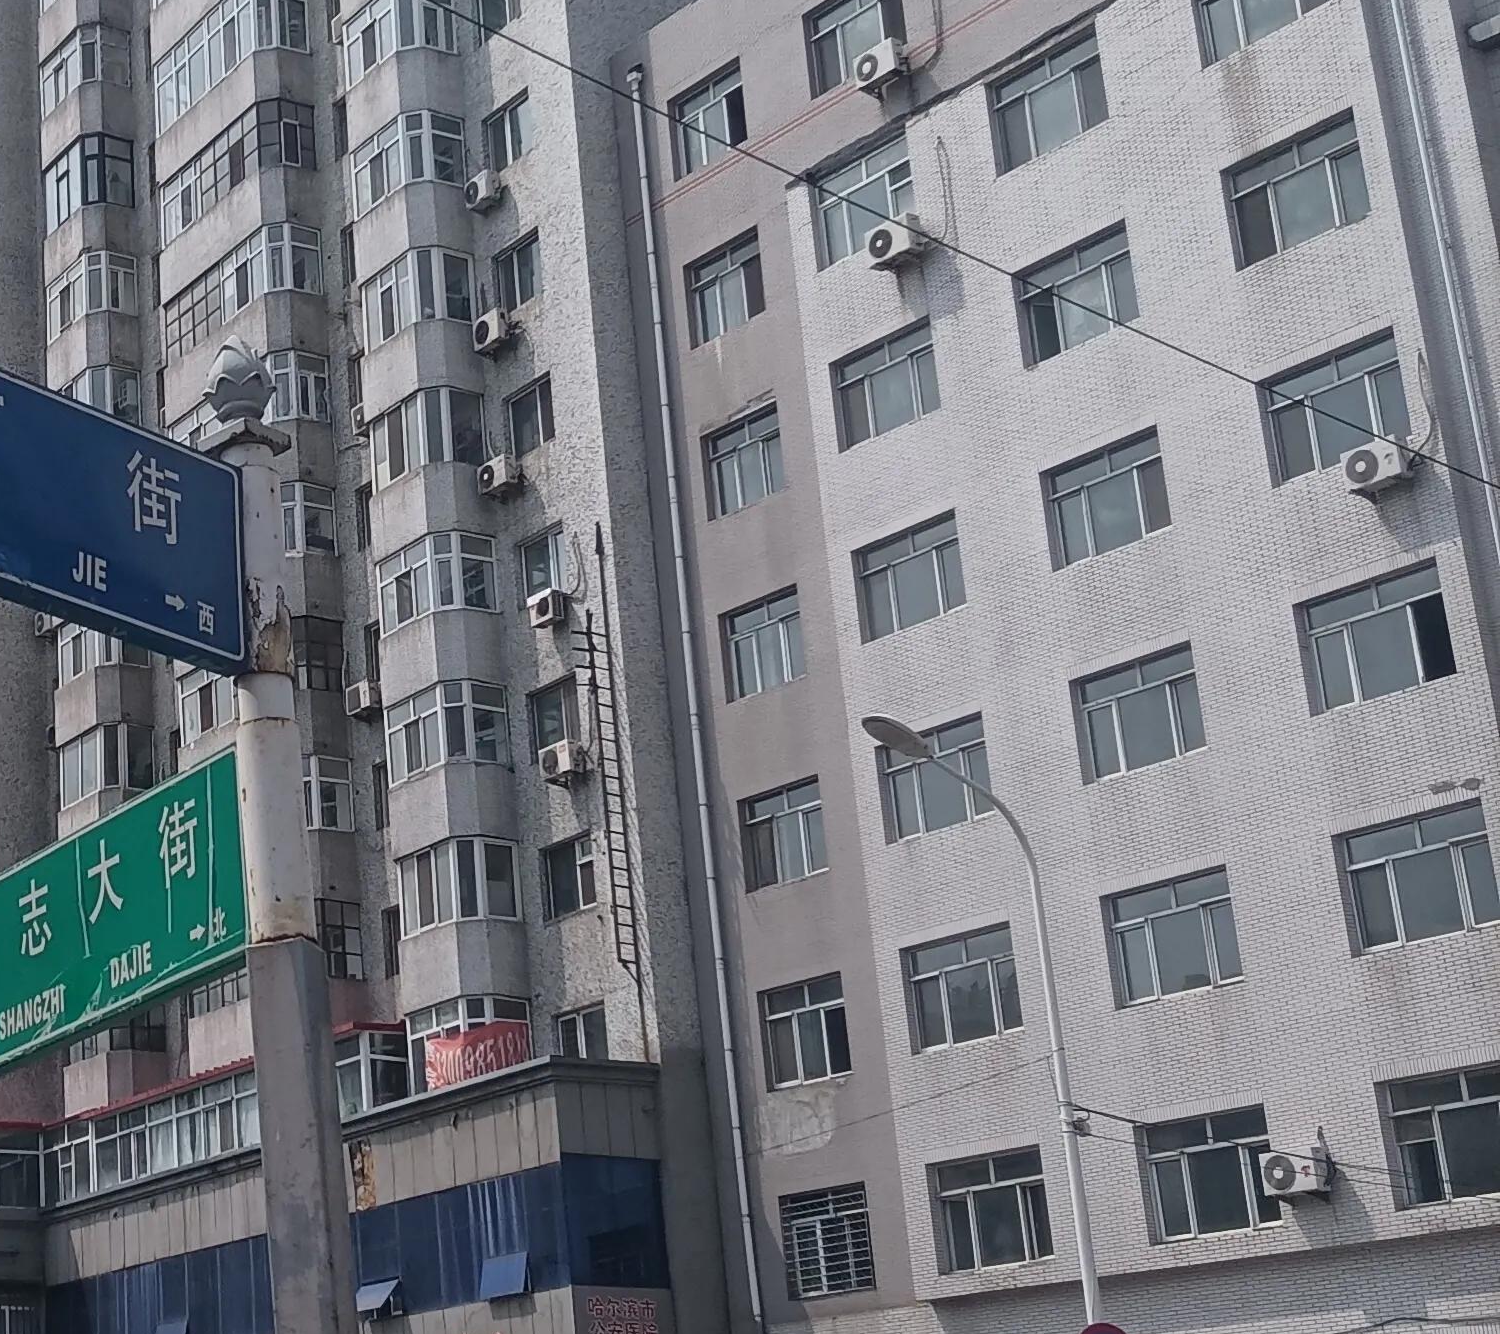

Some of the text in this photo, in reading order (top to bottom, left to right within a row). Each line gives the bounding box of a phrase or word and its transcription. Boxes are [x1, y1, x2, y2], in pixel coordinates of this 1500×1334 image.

[72, 550, 107, 593] JIE
[196, 599, 216, 637] 西
[213, 907, 227, 940] 北
[0, 941, 152, 1041] SHANGZHI DAJIE
[587, 1296, 656, 1318] 哈尔滨市
